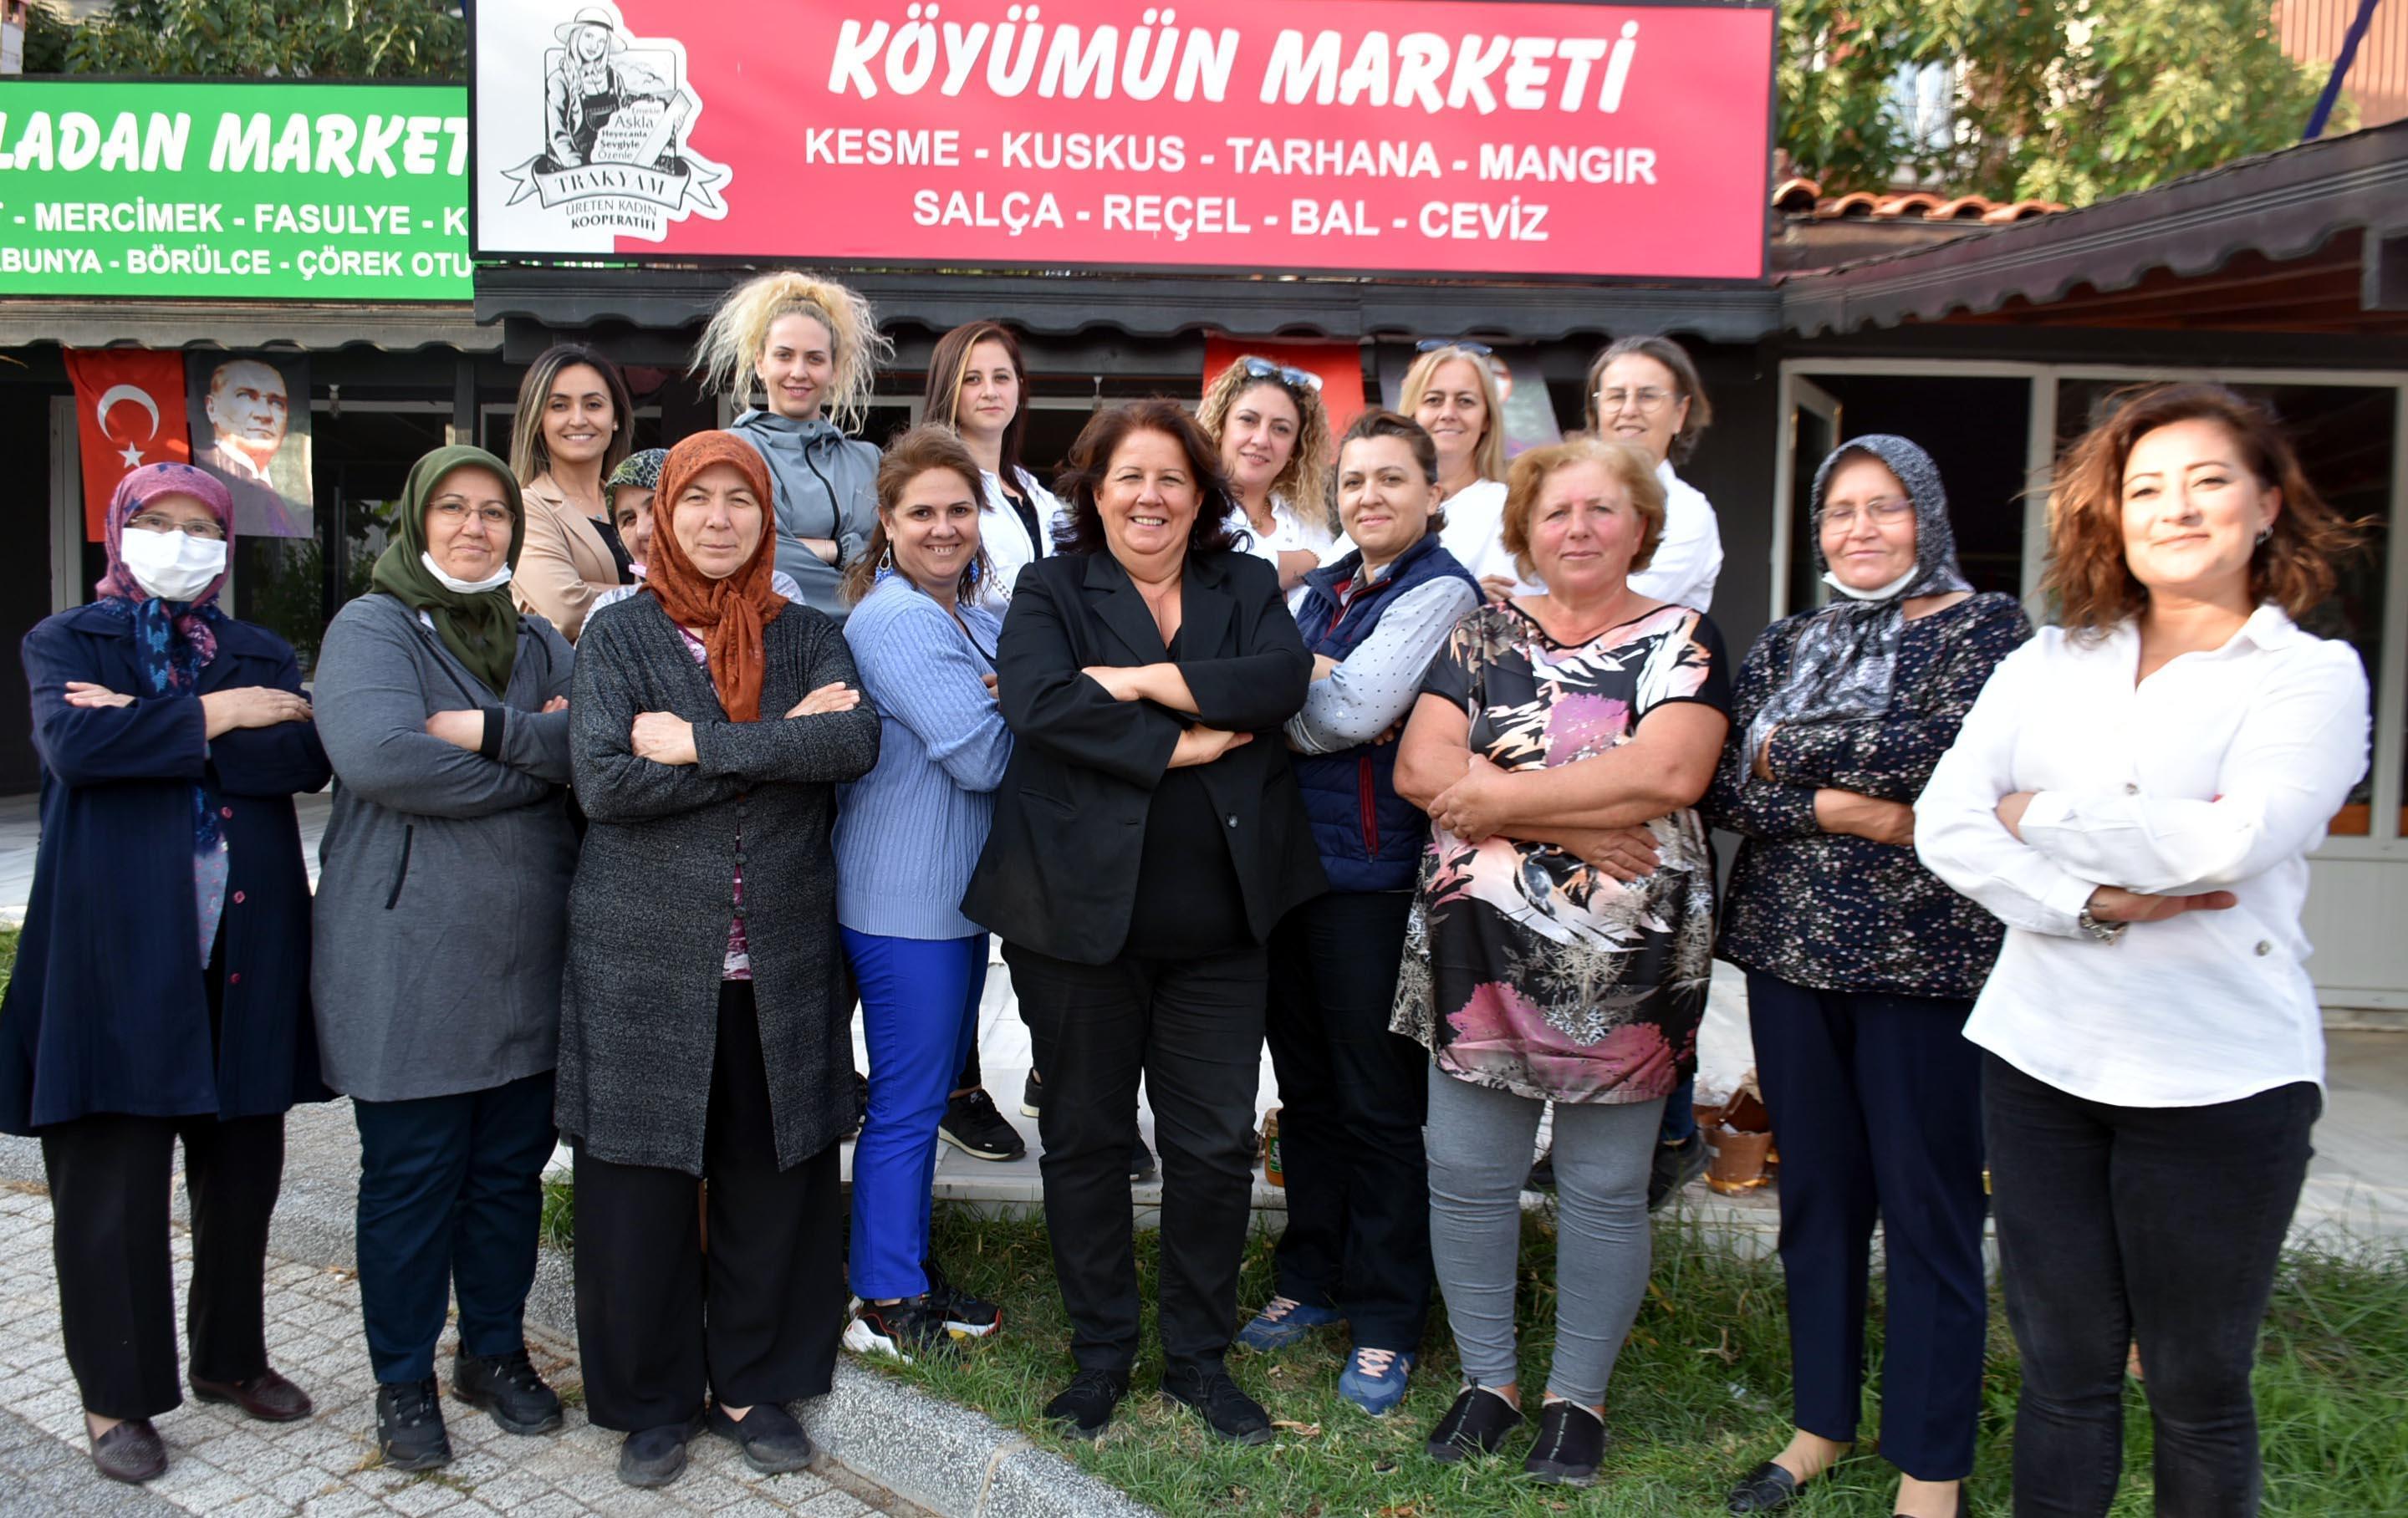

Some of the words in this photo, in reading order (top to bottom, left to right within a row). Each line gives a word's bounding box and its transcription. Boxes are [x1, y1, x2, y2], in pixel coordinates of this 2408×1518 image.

[828, 3, 1240, 102] KÖYÜMÜN
[1259, 18, 1639, 115] MARKETİ
[0, 111, 191, 172] LADAN
[805, 128, 960, 166] KESME
[1002, 131, 1186, 172] KUSKUS
[1226, 137, 1442, 179] TARHANA
[1479, 143, 1657, 185] MANGIR
[555, 171, 665, 196] TRAKYAM
[34, 196, 223, 232] MERCİMEK
[254, 203, 411, 235] FASULYE
[619, 200, 657, 216] KADIN
[913, 189, 1064, 237] SALÇA
[1103, 194, 1252, 242] REÇEL
[1291, 199, 1380, 236] BAL
[1419, 196, 1549, 241] CEVİZ
[0, 247, 103, 274] BUNYA
[126, 243, 271, 275] BÖRÜLCE
[297, 245, 404, 281] ÇÖREK
[411, 252, 472, 278] OTU
